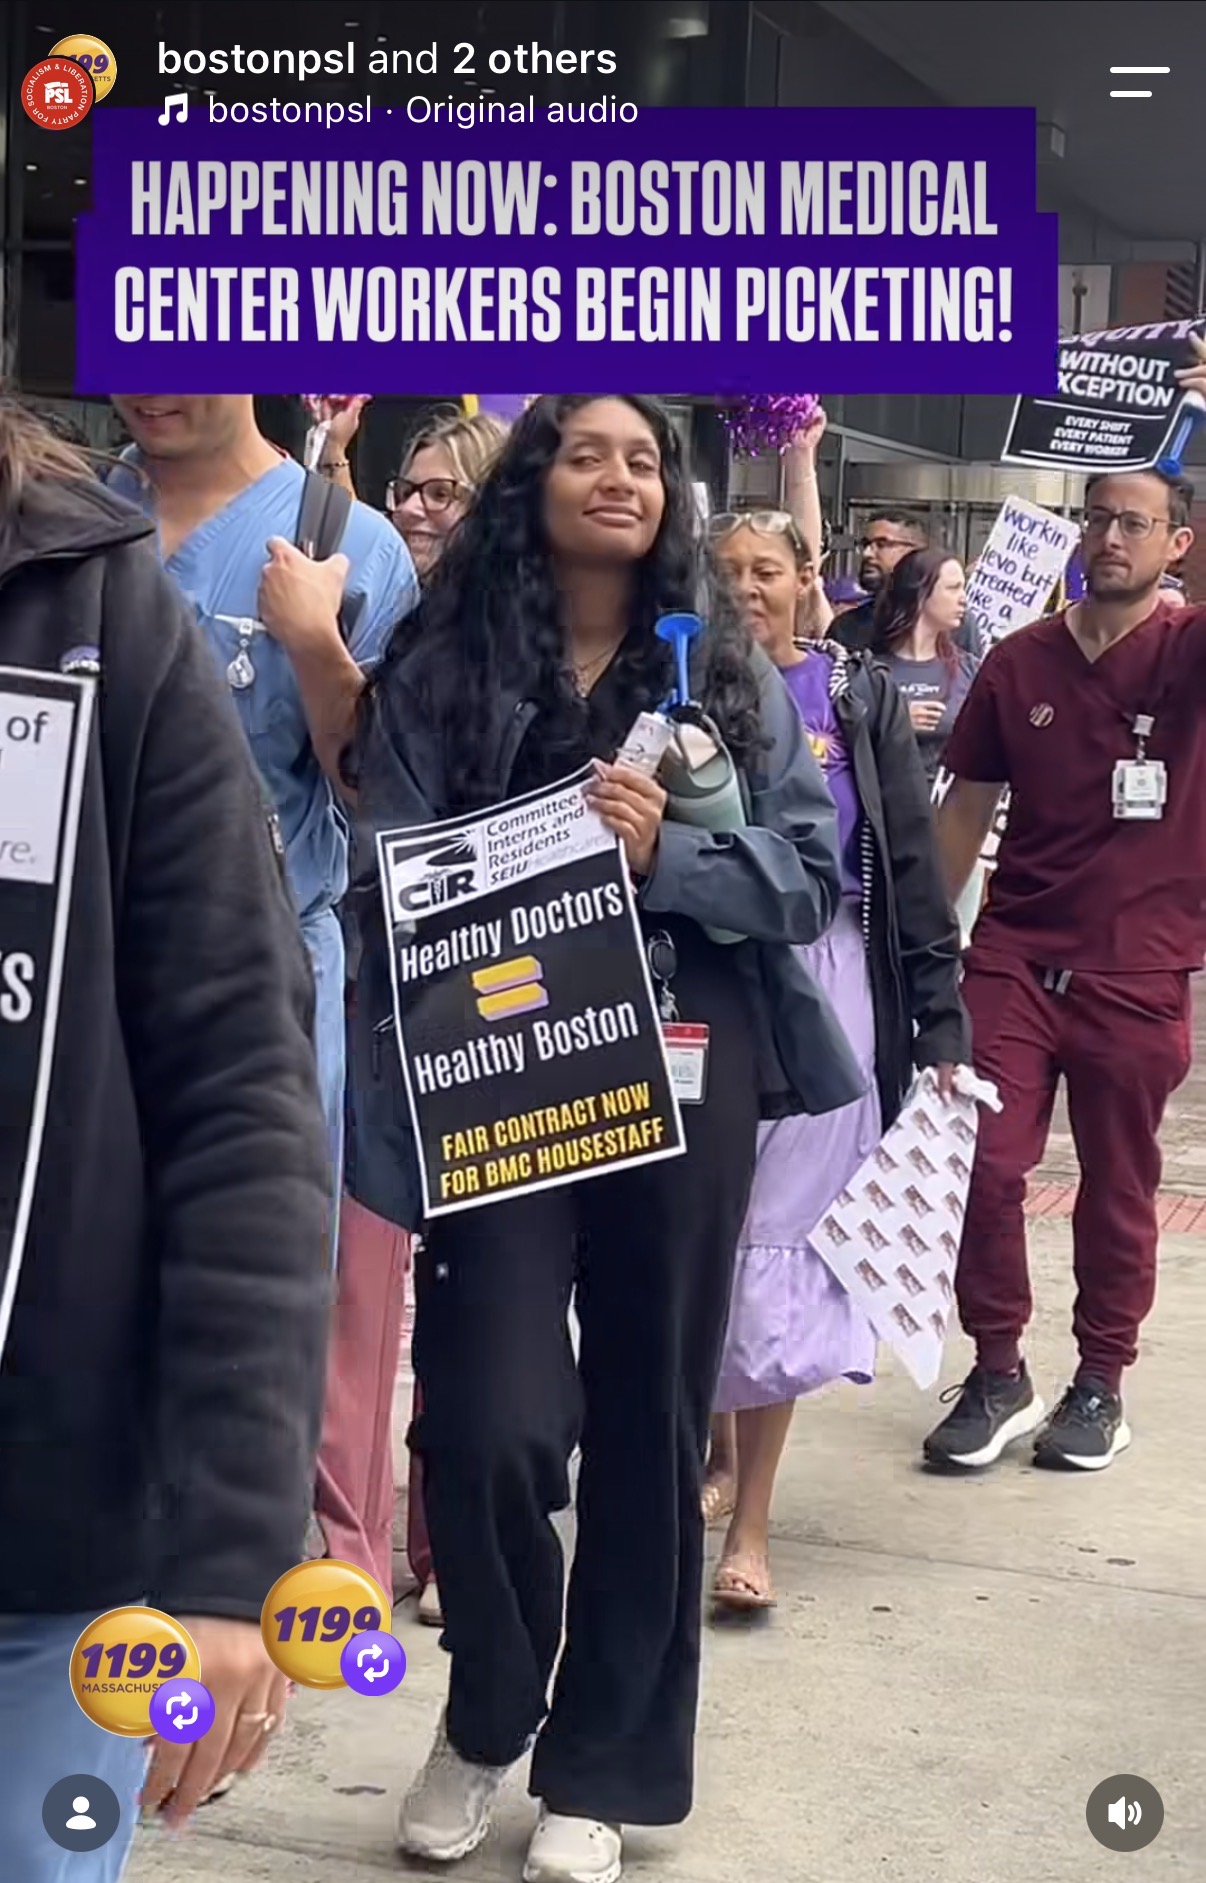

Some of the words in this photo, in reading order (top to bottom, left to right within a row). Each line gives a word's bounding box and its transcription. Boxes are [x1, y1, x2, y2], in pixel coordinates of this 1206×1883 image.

[1058, 319, 1193, 347] QUITY
[1059, 349, 1170, 383] WITHOUT
[1058, 371, 1175, 408] XCEPTION
[1006, 532, 1039, 561] like
[976, 566, 1038, 608] treated
[1021, 564, 1054, 591] but
[999, 604, 1013, 622] a
[6, 710, 49, 744] of
[486, 793, 578, 837] Committee
[487, 821, 548, 853] Interns
[551, 805, 585, 829] and
[488, 828, 571, 870] Residents
[401, 918, 503, 983] Healthy
[510, 882, 625, 946] Doctors
[0, 952, 35, 1022] S
[413, 1031, 525, 1094] Healthy
[532, 1001, 640, 1061] Boston
[441, 1124, 490, 1161] FAIR
[494, 1096, 598, 1149] CONTRACT
[601, 1081, 652, 1121] NOW
[439, 1161, 481, 1198] FOR
[485, 1150, 533, 1187] BMC
[536, 1115, 664, 1176] HOUSESTAFF
